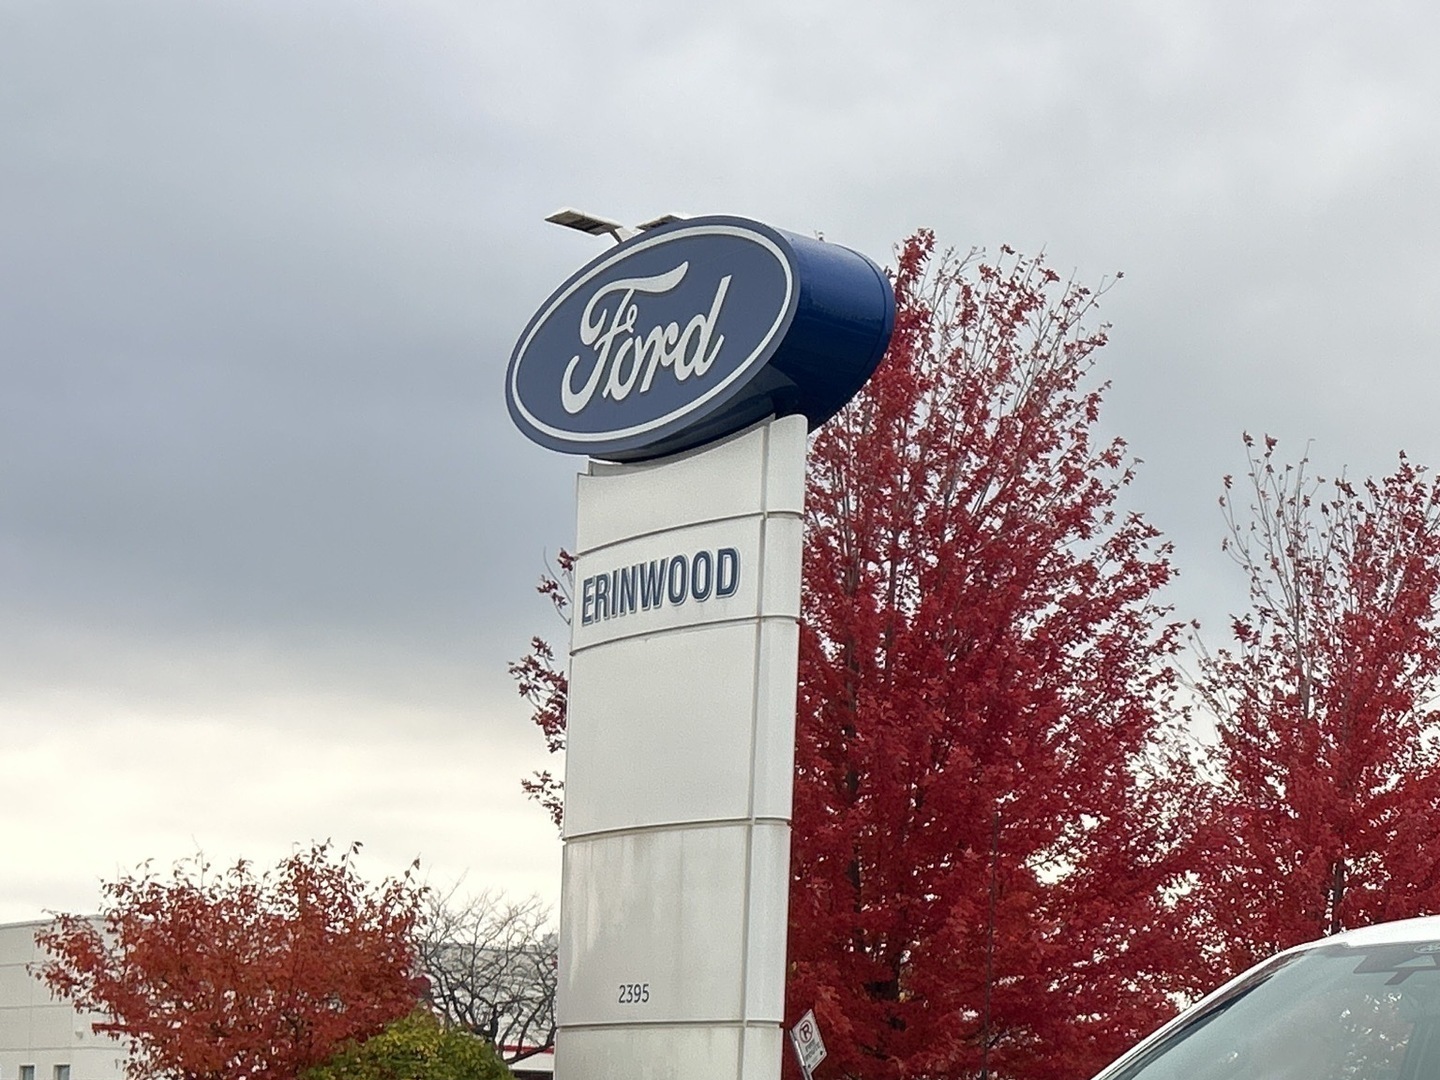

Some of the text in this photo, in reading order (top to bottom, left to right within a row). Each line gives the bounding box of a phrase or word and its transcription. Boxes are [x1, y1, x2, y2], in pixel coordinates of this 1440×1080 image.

[562, 261, 732, 414] Ford
[582, 547, 741, 627] ERINWOOD
[618, 983, 650, 1003] 2395
